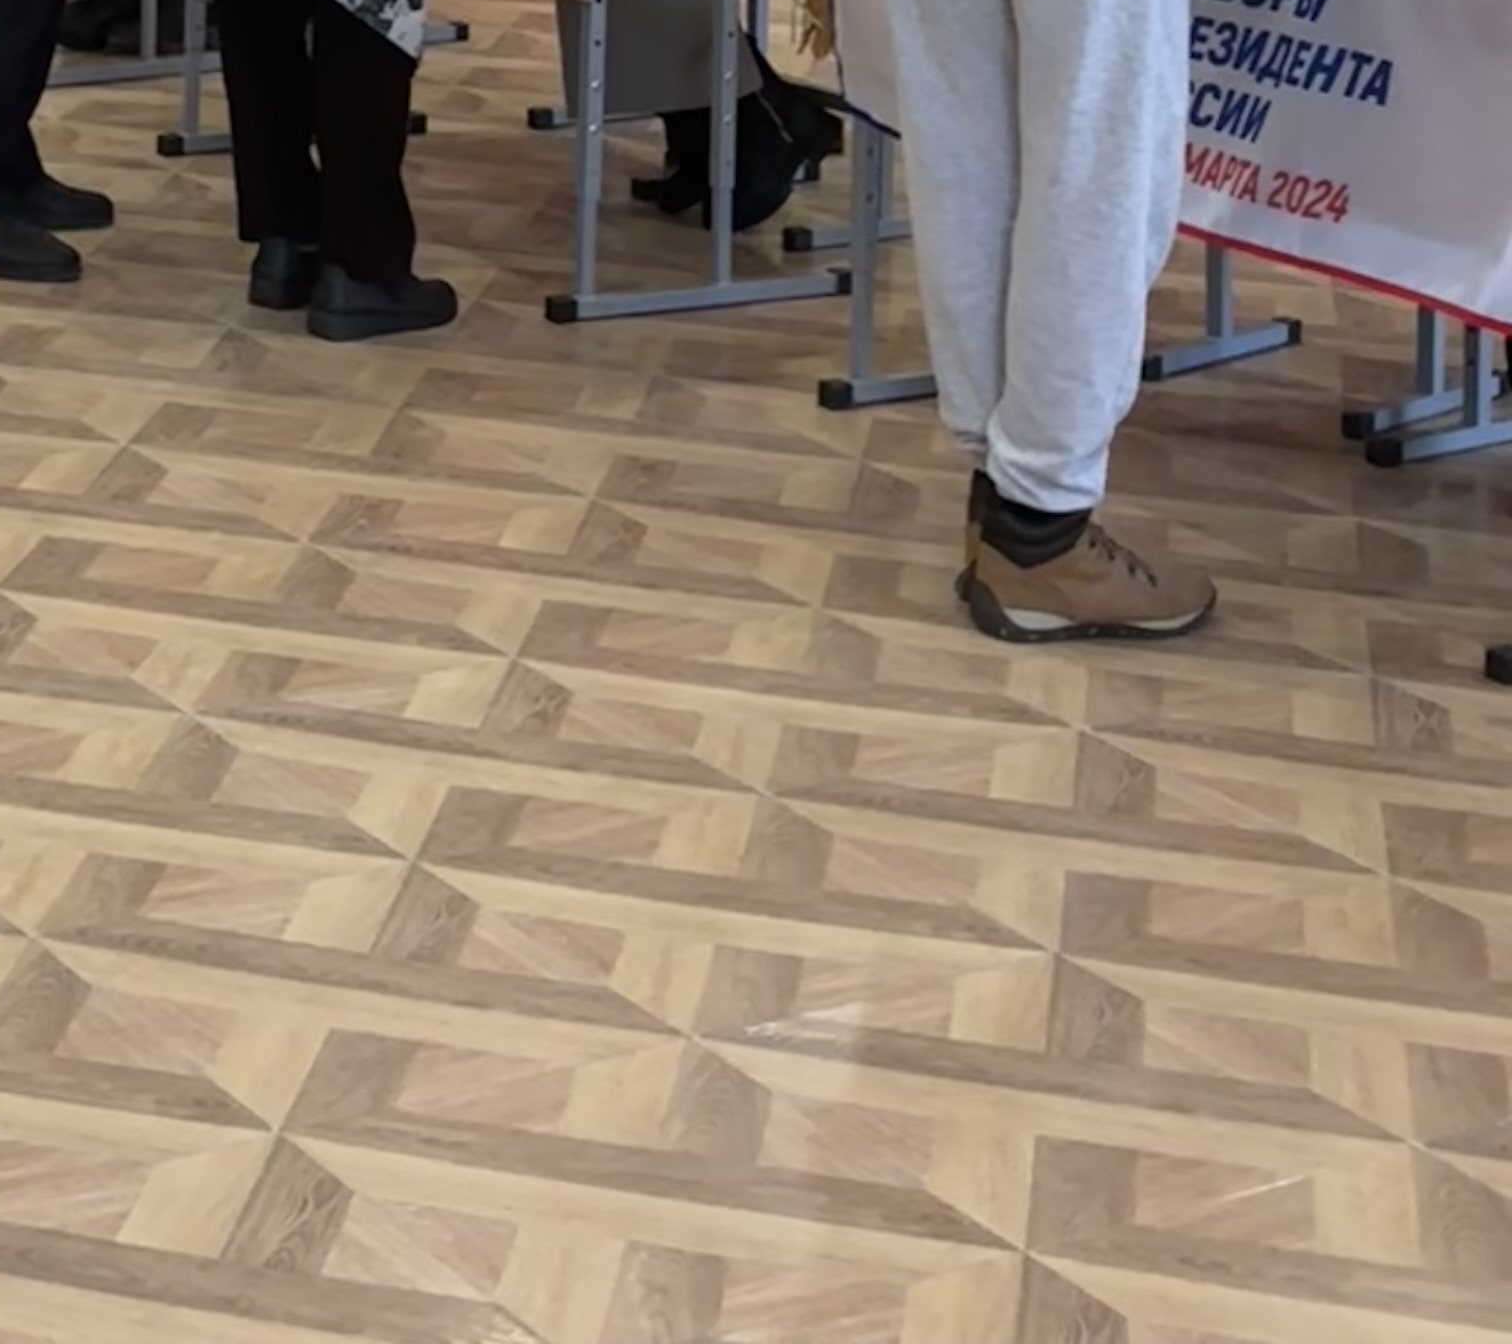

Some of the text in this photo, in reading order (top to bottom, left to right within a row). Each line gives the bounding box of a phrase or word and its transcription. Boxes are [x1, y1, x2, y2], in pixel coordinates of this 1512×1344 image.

[1189, 16, 1394, 107] ЕЗИДЕНТА
[1188, 80, 1272, 144] СИИ
[1185, 141, 1352, 223] МАРТА 2024
